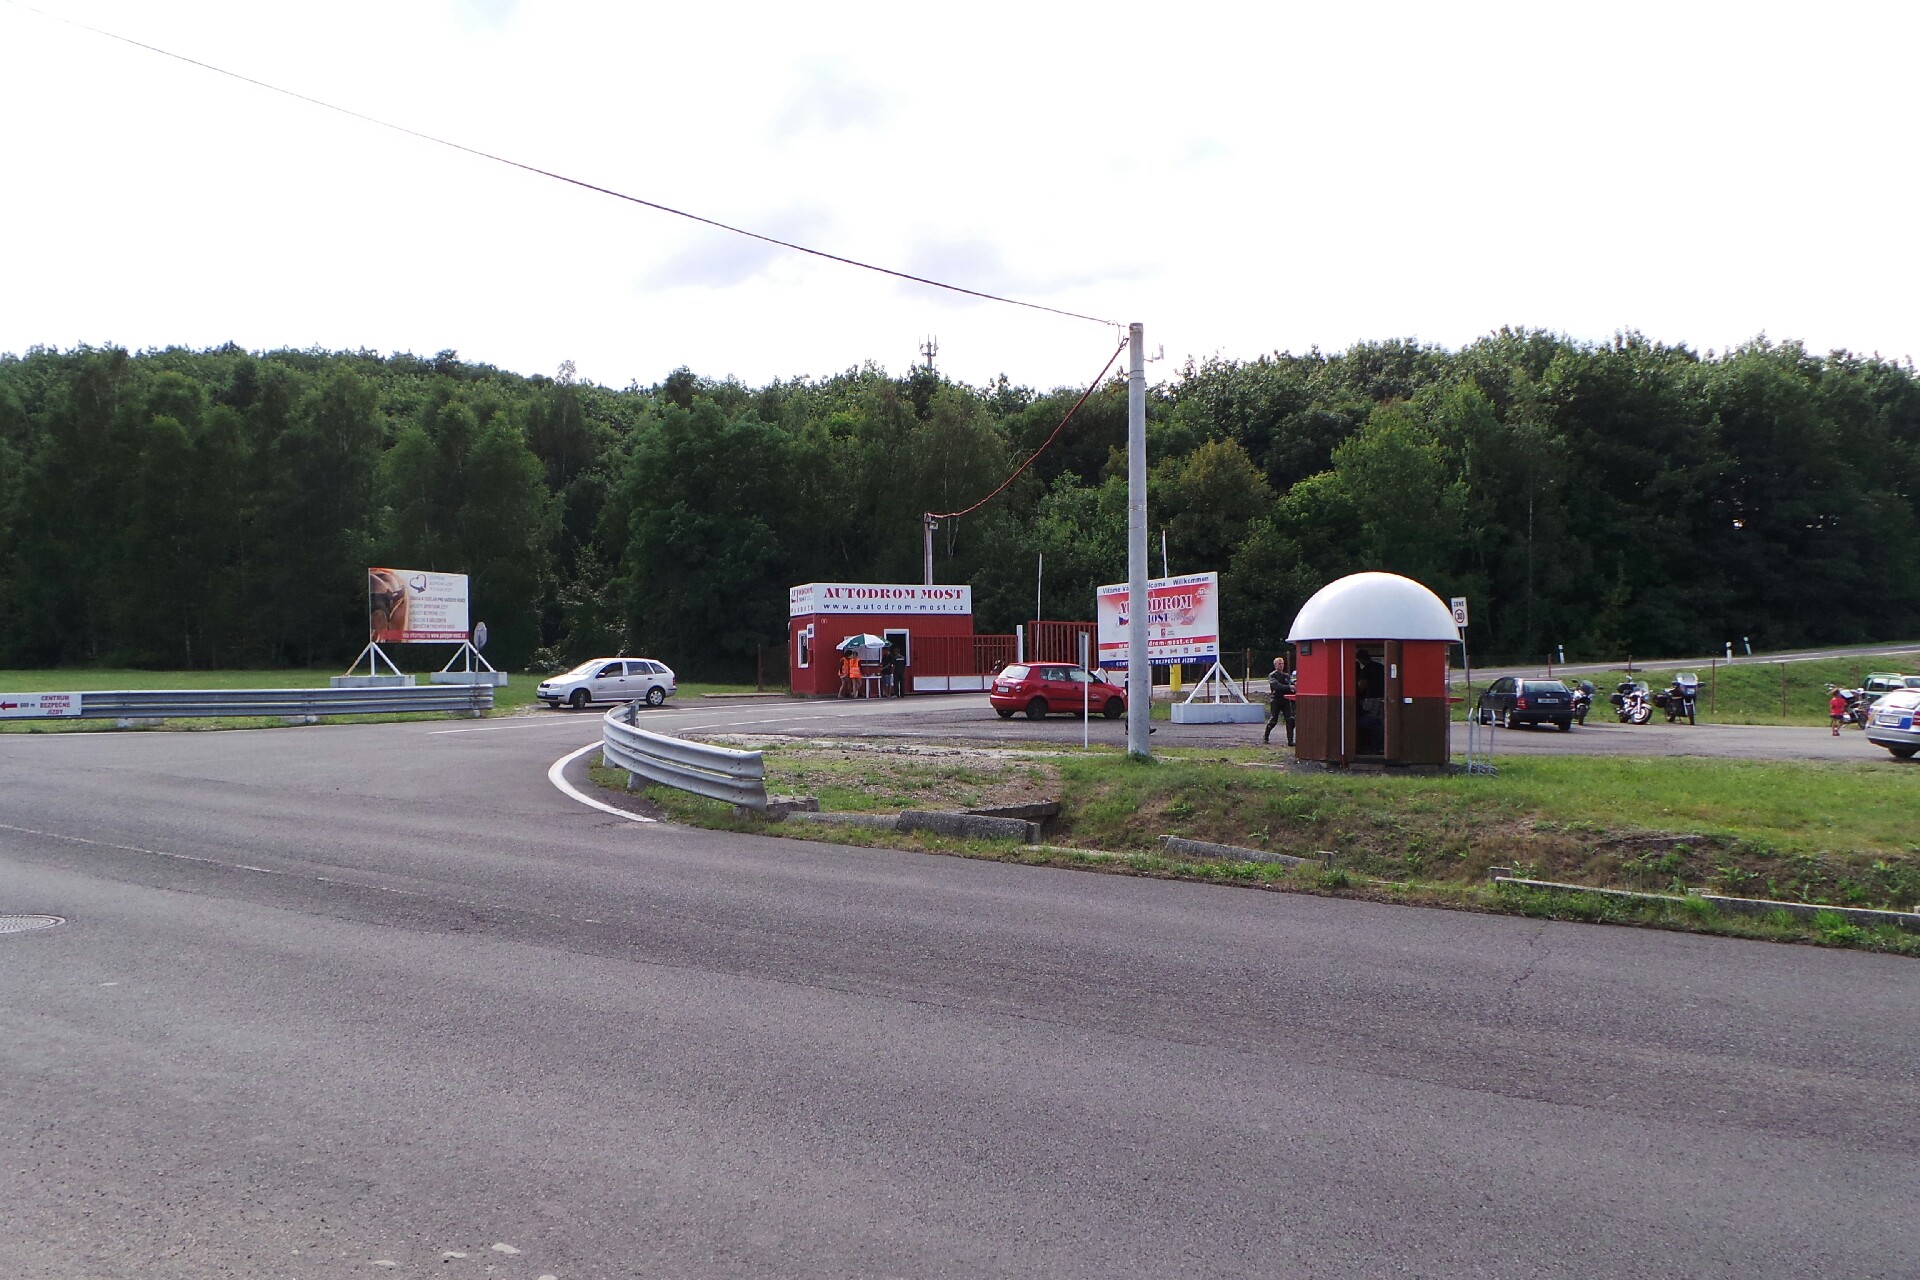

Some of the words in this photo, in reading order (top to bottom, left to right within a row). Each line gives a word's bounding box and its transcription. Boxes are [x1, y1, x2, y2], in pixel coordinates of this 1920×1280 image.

[823, 587, 916, 600] AUTODROM
[920, 589, 964, 600] MOST
[823, 602, 964, 611] www.autodrom-most.cz
